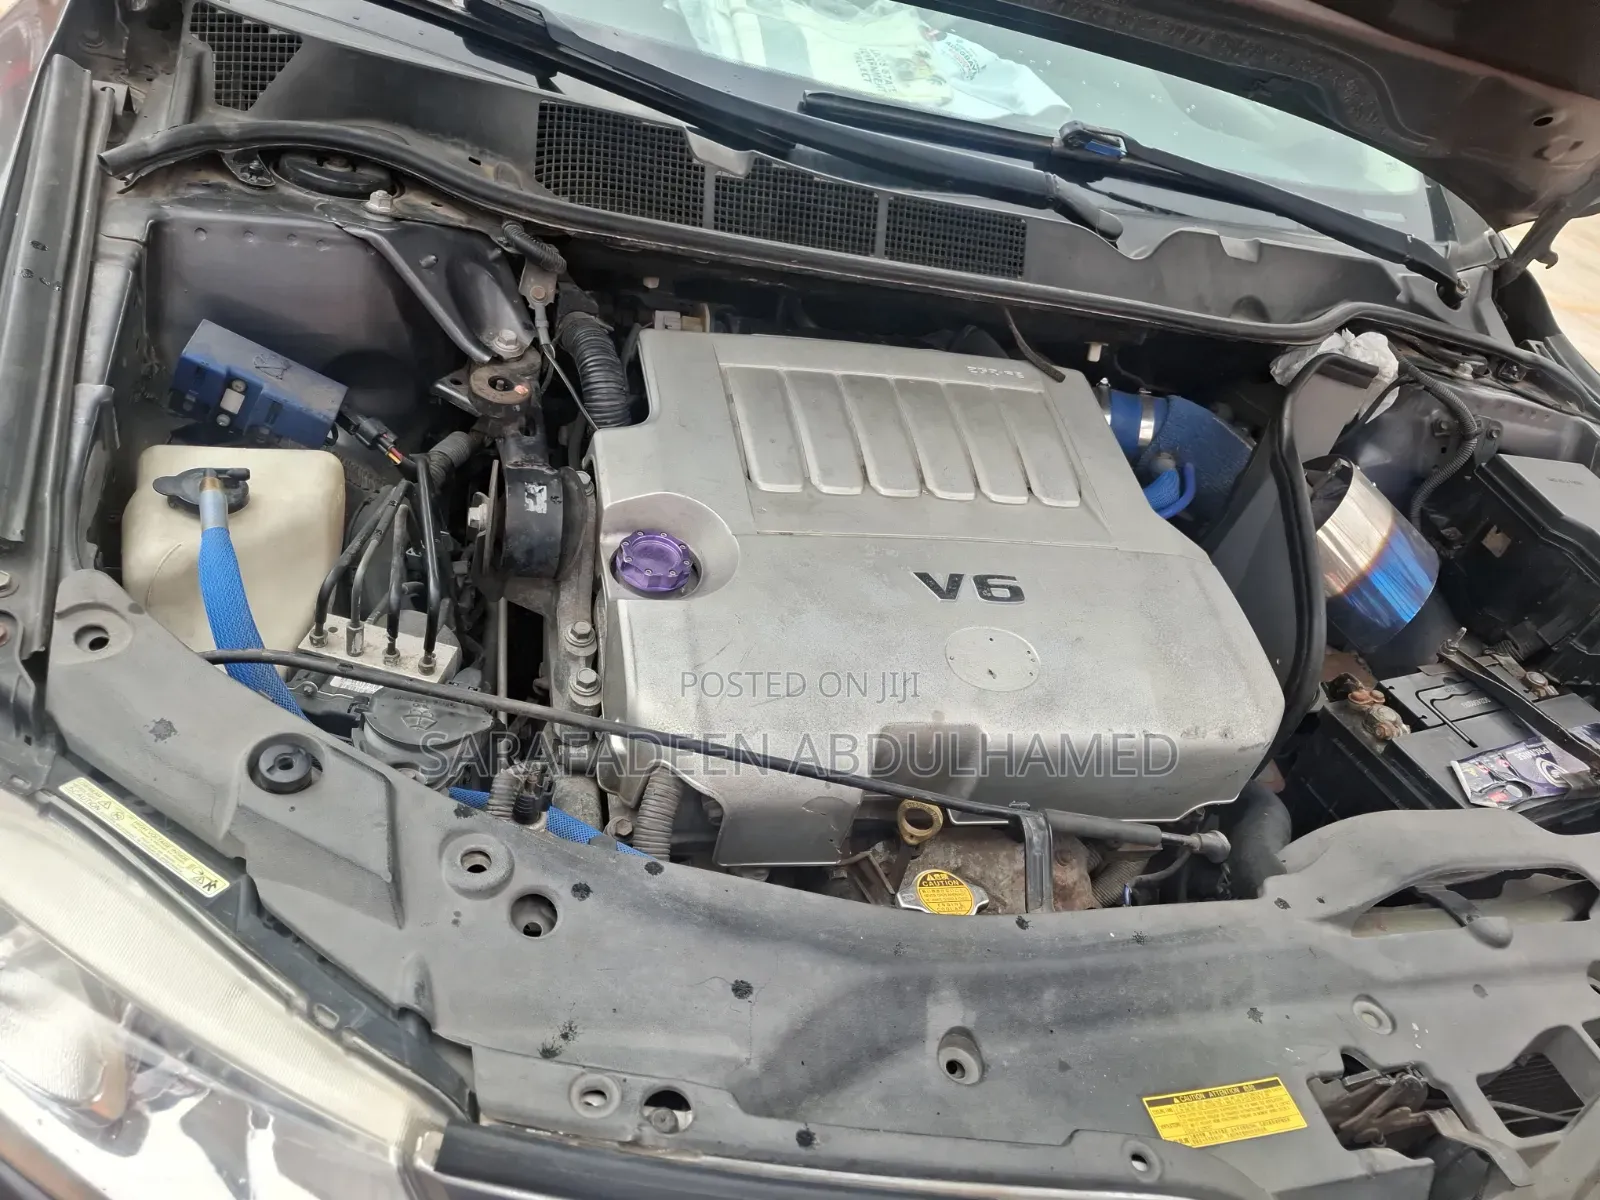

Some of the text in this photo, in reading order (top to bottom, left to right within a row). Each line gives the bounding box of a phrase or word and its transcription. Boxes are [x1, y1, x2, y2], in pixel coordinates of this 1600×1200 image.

[911, 571, 1026, 603] V6
[1179, 1092, 1206, 1103] CAUTION
[1208, 1086, 1241, 1098] ATTENTION
